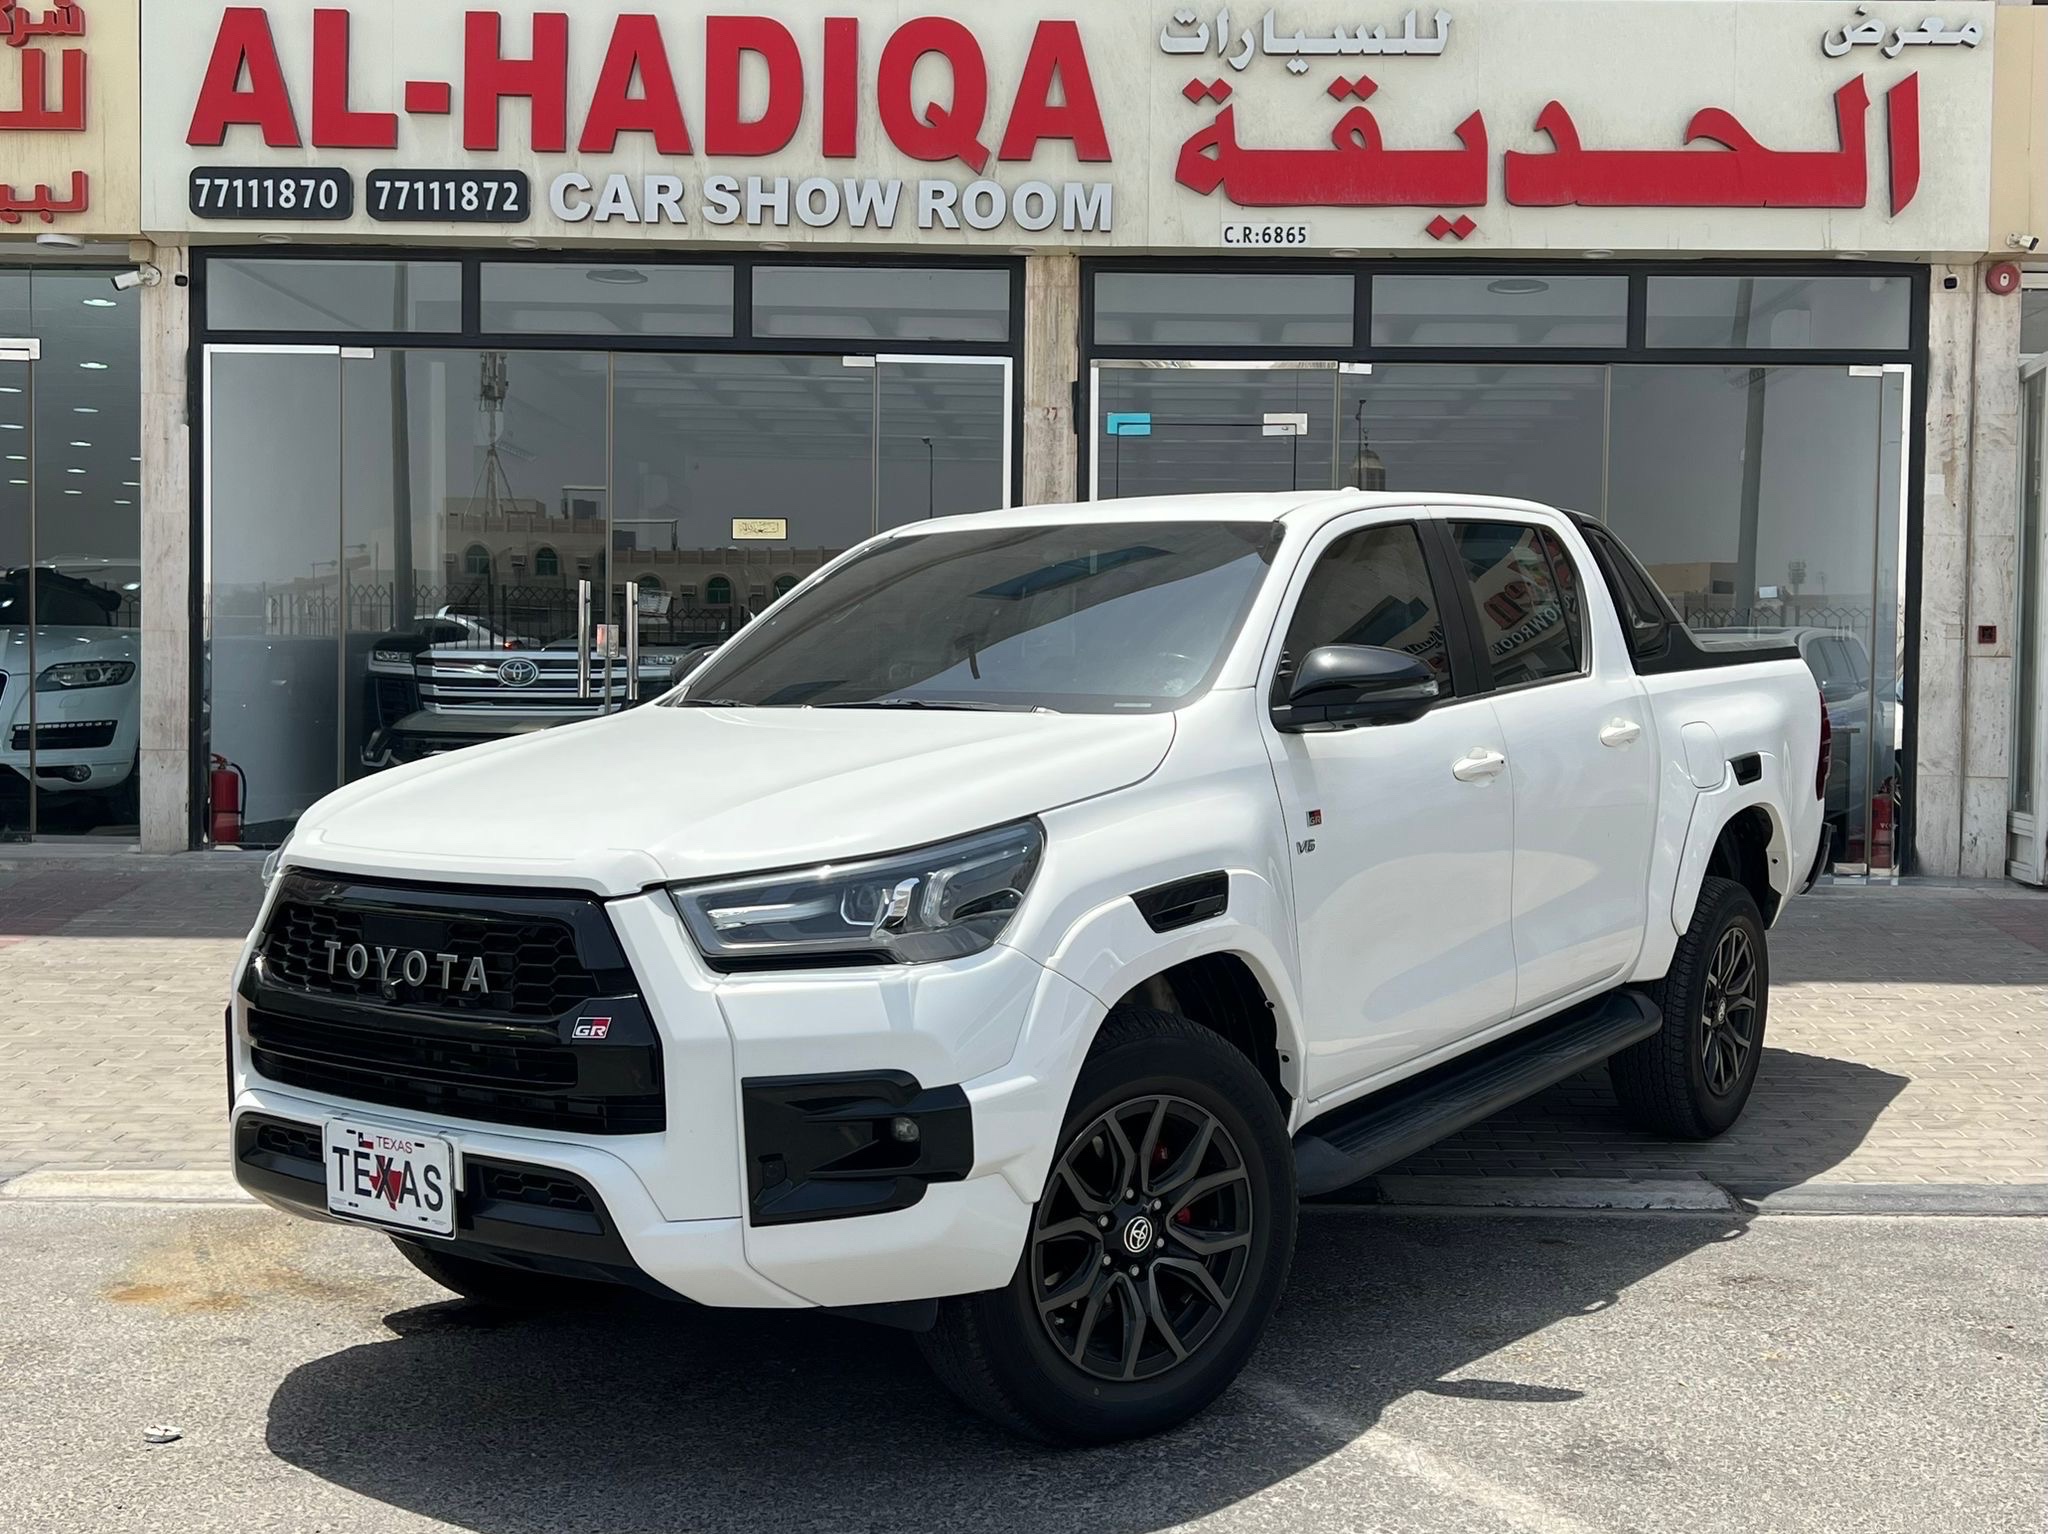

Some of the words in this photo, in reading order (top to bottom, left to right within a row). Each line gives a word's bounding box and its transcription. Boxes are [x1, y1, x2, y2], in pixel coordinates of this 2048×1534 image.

[1160, 8, 1452, 75] للسيارات
[1822, 5, 1983, 59] معرض
[186, 7, 1112, 175] AL-HADIQA
[1175, 71, 1920, 240] الحديقة
[195, 178, 339, 209] 77111870
[375, 181, 519, 211] 77111872
[549, 172, 687, 224] CAR
[702, 175, 902, 227] SHOW
[918, 180, 1113, 232] ROOM
[1223, 226, 1307, 244] C.R:6865
[1296, 839, 1316, 855] V6
[324, 940, 489, 994] TOYOTA
[574, 1023, 608, 1037] GR
[376, 1135, 413, 1154] TEXAS
[332, 1146, 444, 1212] TEXAS
